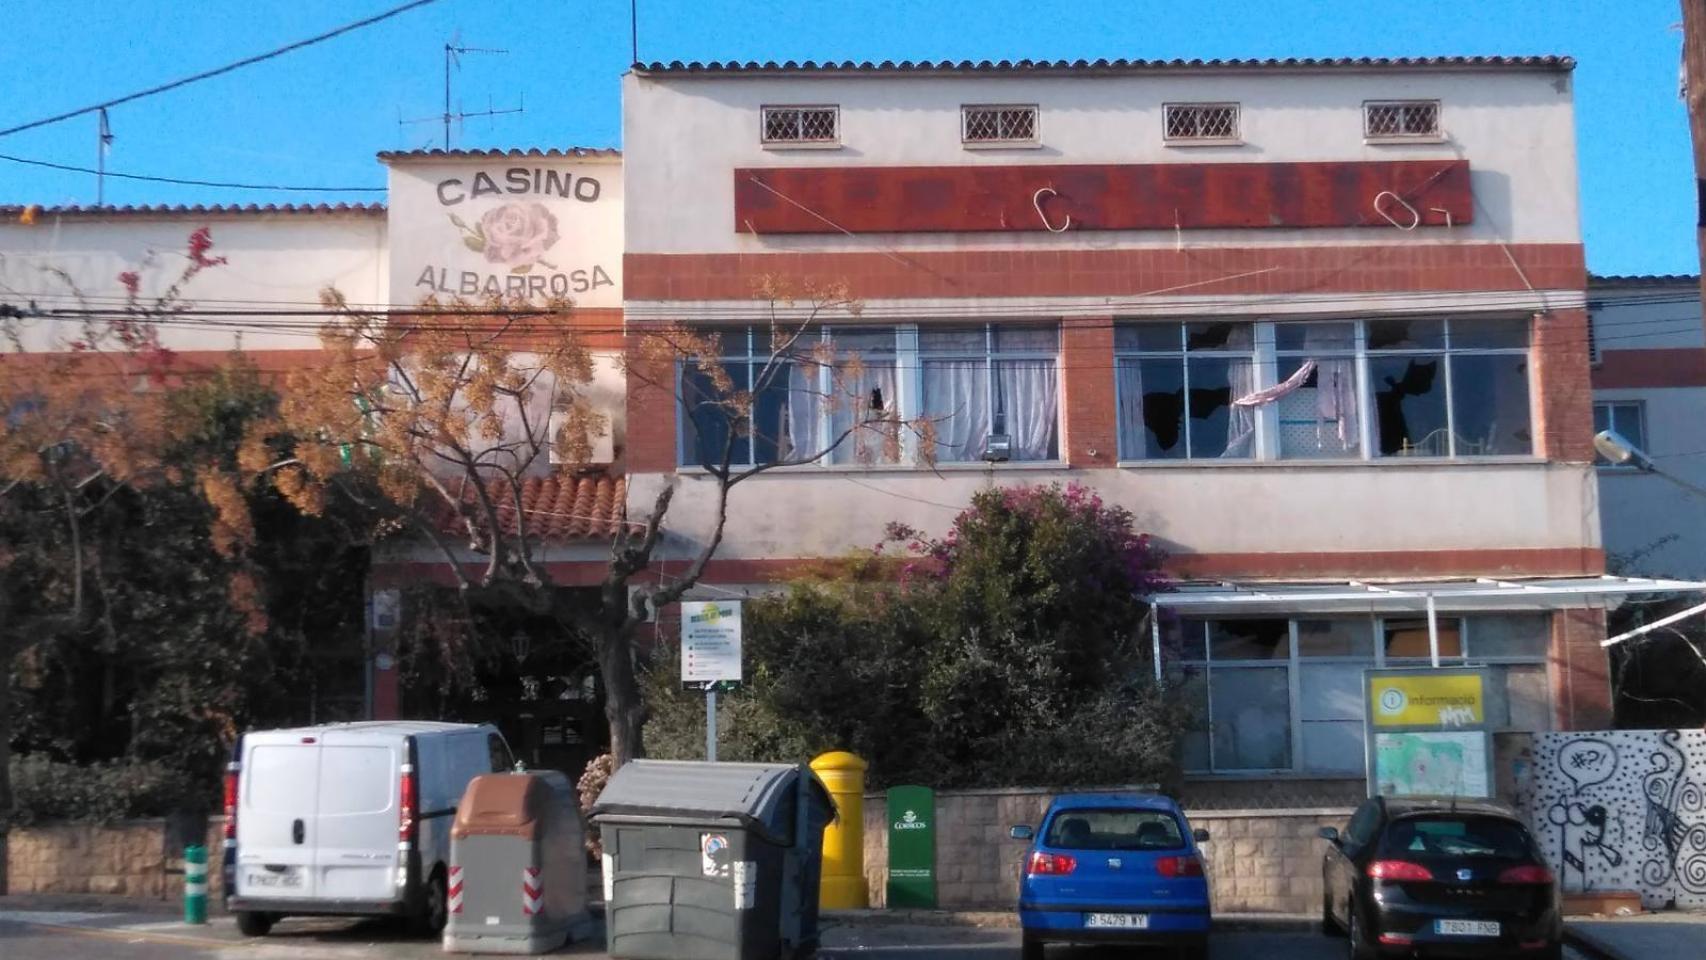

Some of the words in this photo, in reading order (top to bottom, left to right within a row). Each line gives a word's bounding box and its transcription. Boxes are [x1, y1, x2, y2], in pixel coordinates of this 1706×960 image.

[436, 167, 601, 206] CASINO
[416, 264, 614, 299] ALBARROSA
[1100, 915, 1126, 926] 5479
[1131, 914, 1144, 926] WY
